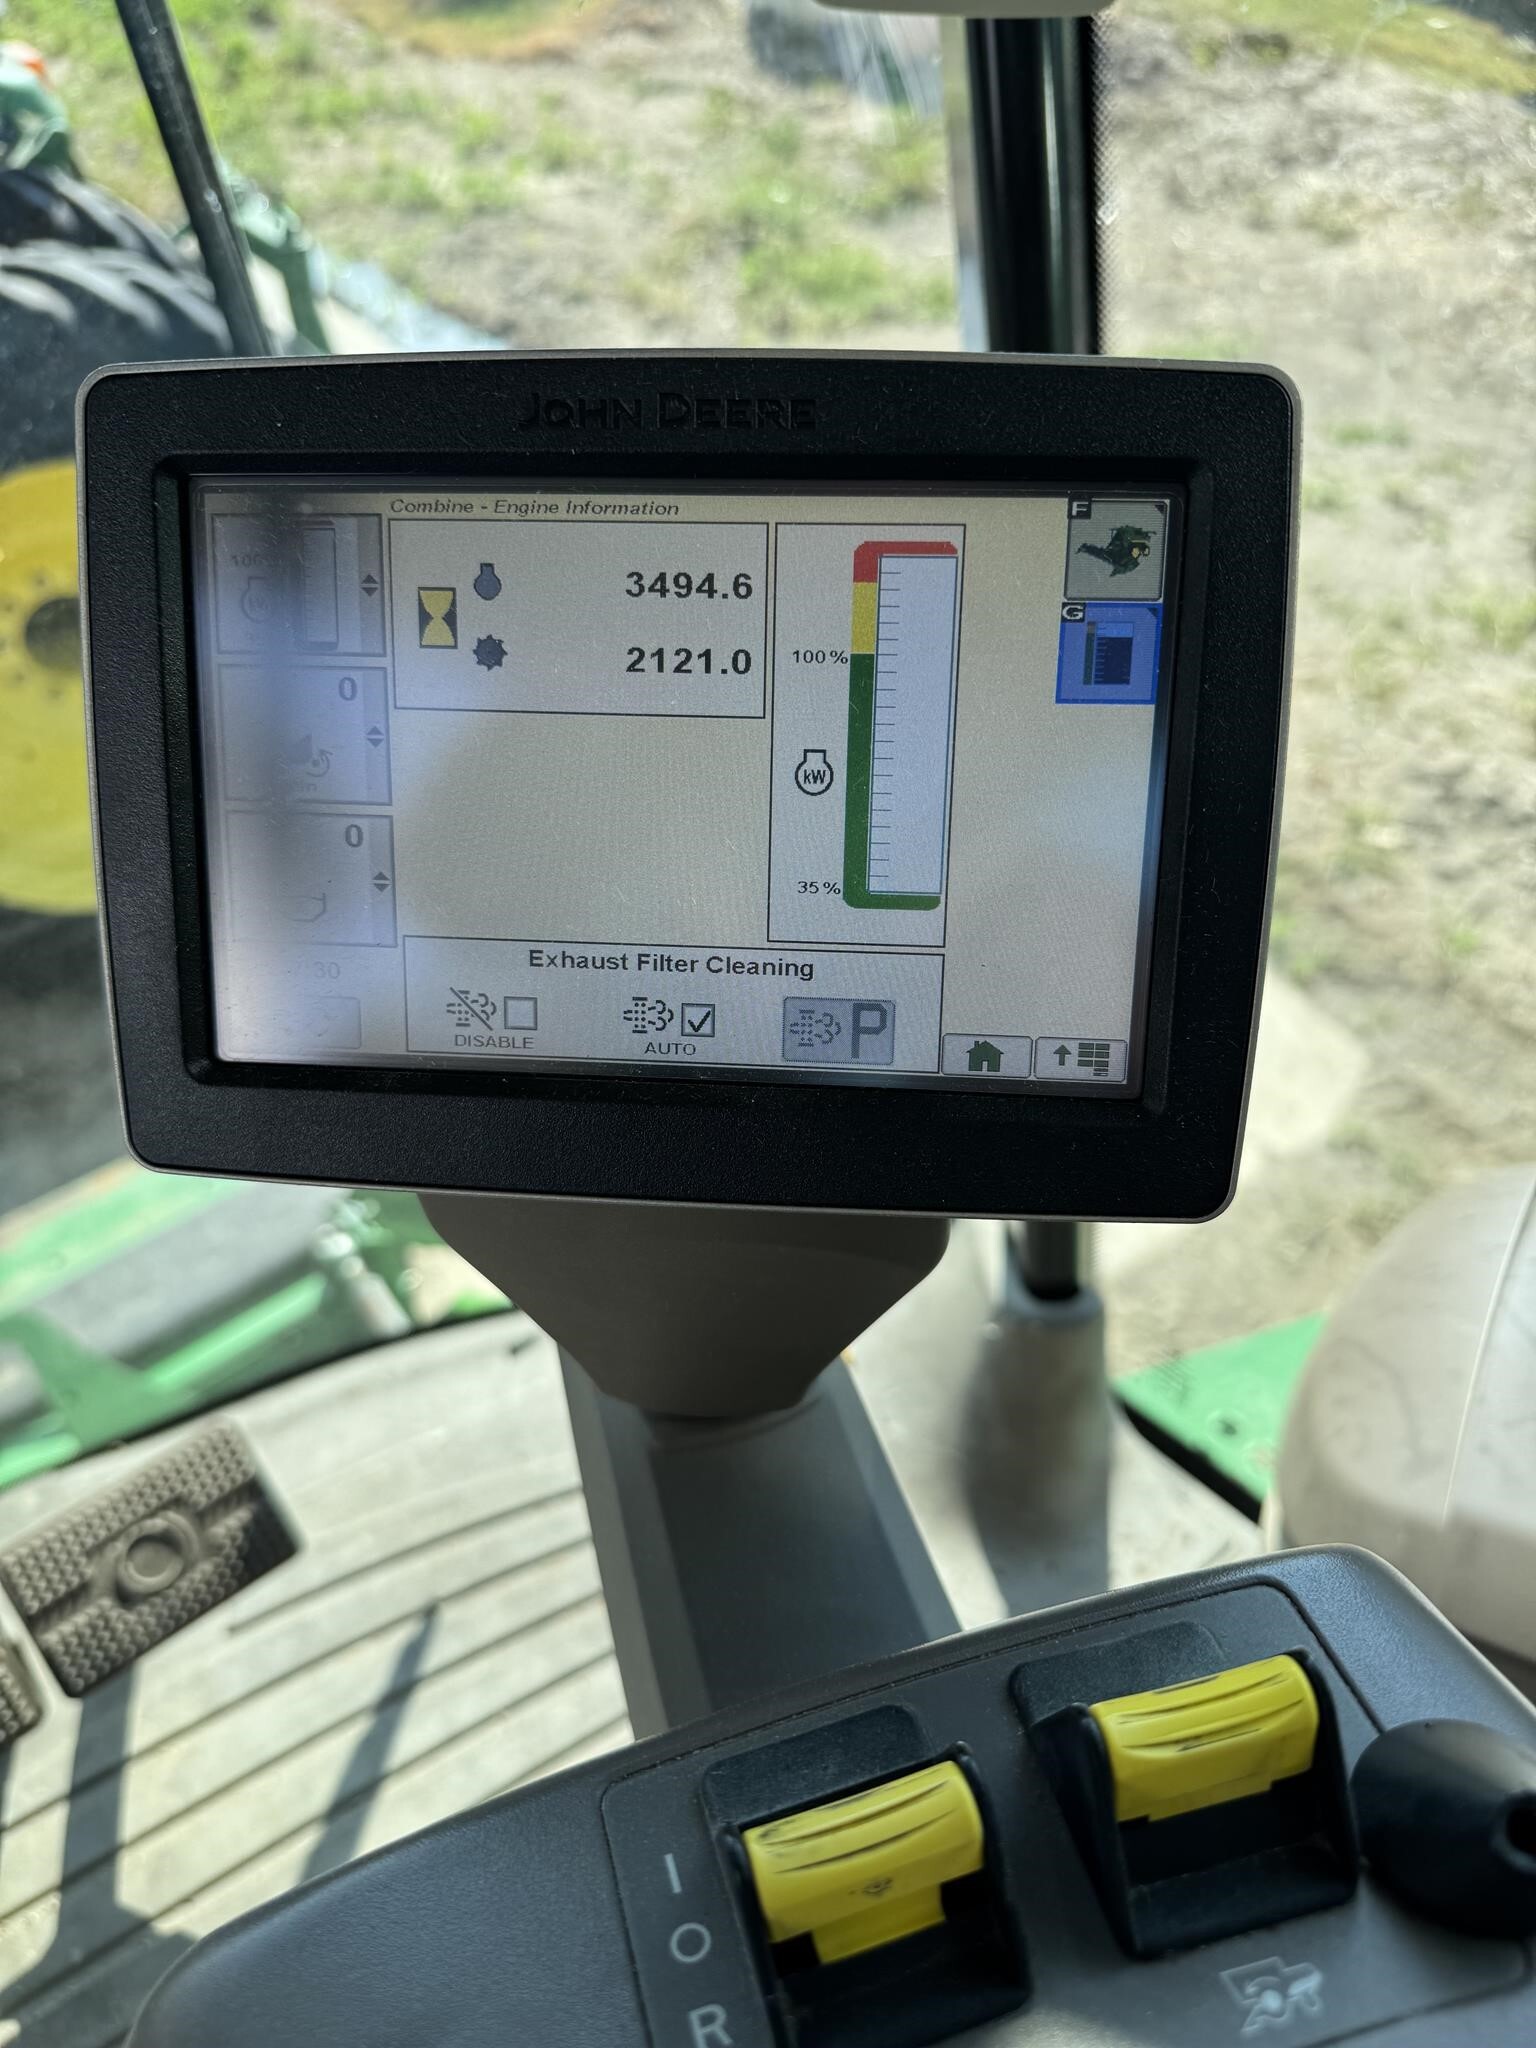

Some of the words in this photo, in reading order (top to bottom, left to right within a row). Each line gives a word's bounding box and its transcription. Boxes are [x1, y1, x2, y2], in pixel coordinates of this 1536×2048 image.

[518, 392, 641, 430] JOHN
[656, 392, 817, 430] DEERE
[390, 498, 474, 513] Combine
[494, 499, 559, 518] Engine
[565, 500, 680, 516] Information
[1072, 501, 1089, 516] F
[625, 571, 753, 600] 3494.6
[1062, 604, 1083, 620] G
[625, 647, 752, 675] 2121.0
[338, 677, 358, 701] 0
[803, 768, 827, 785] kW
[345, 823, 364, 848] 0
[529, 949, 628, 973] Exhaust
[637, 953, 699, 975] Filter
[706, 956, 815, 981] Cleaning
[454, 1035, 535, 1049] DISABLE
[853, 1003, 889, 1059] P
[644, 1042, 697, 1056] AUTO
[688, 2004, 732, 2048] R
